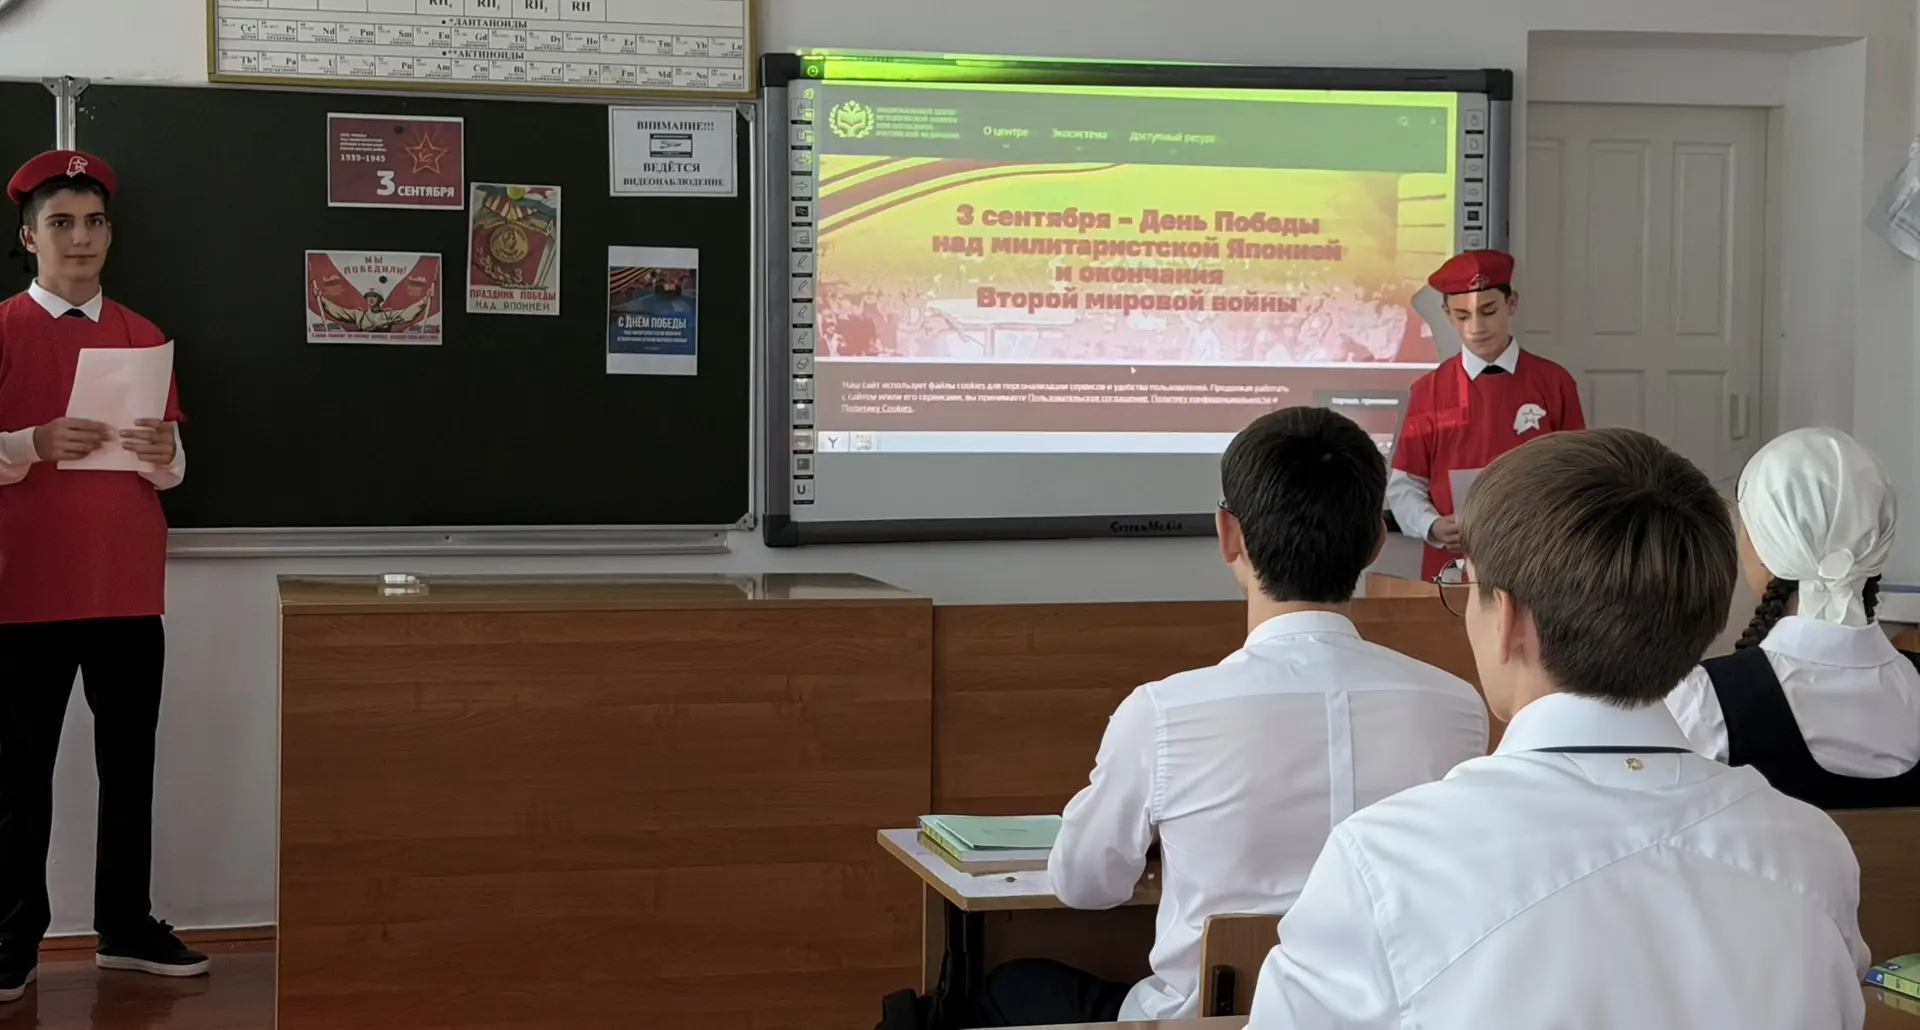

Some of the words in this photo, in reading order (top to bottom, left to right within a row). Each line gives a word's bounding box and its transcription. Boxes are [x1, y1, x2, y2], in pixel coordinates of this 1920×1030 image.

[572, 1, 591, 12] RH
[322, 27, 335, 35] Nd
[360, 28, 374, 37] Pm
[398, 30, 412, 38] Sm
[475, 32, 488, 41] Gd
[550, 35, 561, 44] Dy
[437, 63, 450, 71] Am
[637, 120, 714, 131] ВНИМАНИЕ!!!
[992, 127, 1030, 138] центре
[1052, 128, 1108, 140] Экосистема
[340, 153, 386, 163] 1939-1945
[643, 160, 700, 174] ВЕДЁТСЯ
[376, 170, 396, 196] 3
[397, 185, 455, 198] СЕНТЯБРЯ
[623, 177, 725, 188] ВИДЕОНАБЛЮДЕНИЕ
[957, 203, 975, 227] 3
[982, 206, 1112, 234] сентября
[1139, 209, 1208, 235] День
[1214, 211, 1320, 237] Победы
[932, 235, 984, 257] над
[991, 236, 1220, 260] милитаристской
[1226, 238, 1343, 261] Японией
[364, 256, 384, 265] МЫ
[344, 265, 407, 275] ПОБЕДИЛИ!
[1055, 266, 1073, 283] и
[1079, 266, 1225, 285] окончания
[469, 289, 515, 300] ПРАЗДНИК
[520, 291, 557, 301] ПОБЕДЫ
[976, 286, 1079, 315] Второй
[1085, 289, 1205, 316] мировой
[1211, 291, 1298, 313] войны
[475, 301, 497, 311] НАД
[503, 301, 550, 311] ЯПОНИЕЙ
[618, 316, 625, 328] С
[651, 316, 687, 329] ПОБЕДЫ
